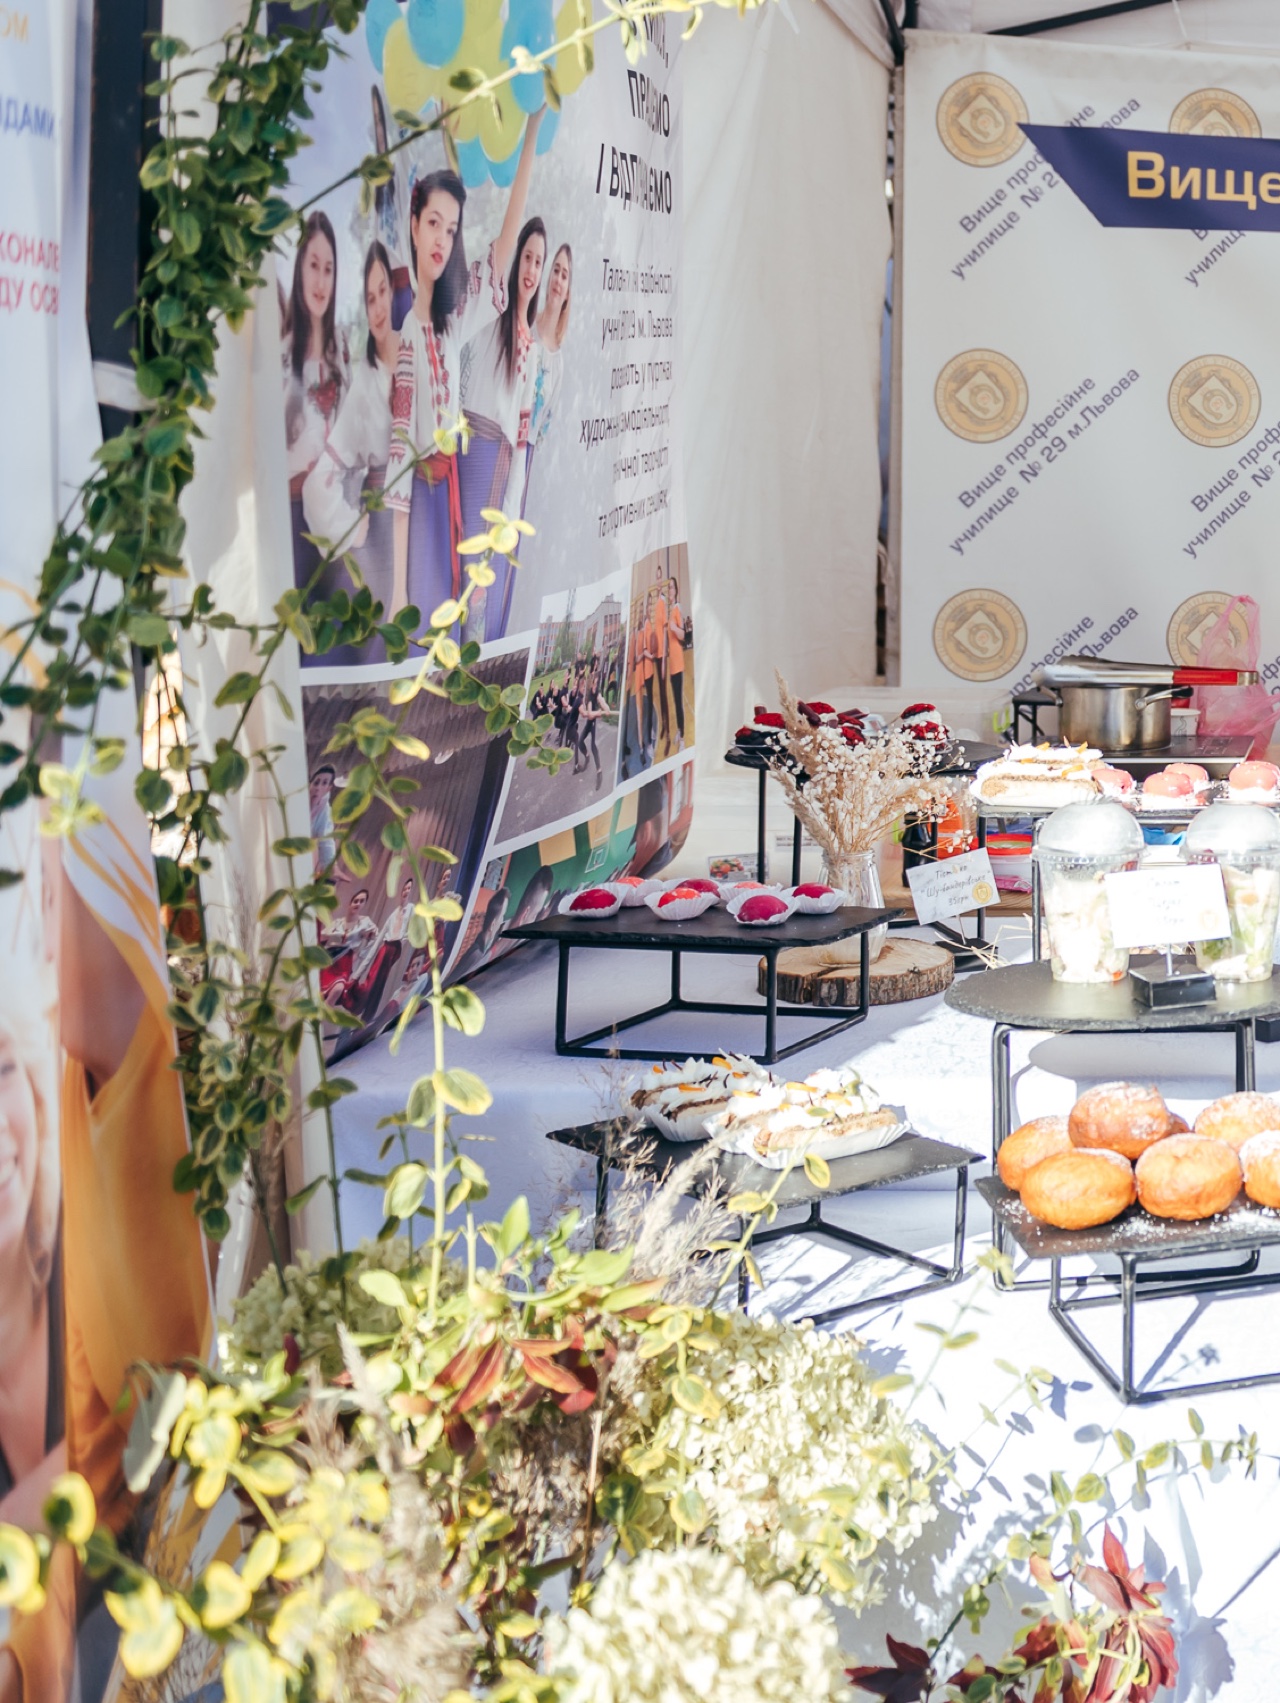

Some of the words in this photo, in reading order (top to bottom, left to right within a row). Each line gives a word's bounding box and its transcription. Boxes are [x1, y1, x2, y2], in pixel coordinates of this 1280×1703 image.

[951, 209, 1021, 280] училище
[1019, 186, 1044, 210] №
[959, 187, 1008, 234] Вище
[949, 485, 1020, 556] училище
[1018, 461, 1044, 484] №
[1040, 435, 1068, 464] 29
[1067, 368, 1141, 440] м.Львова
[957, 464, 1007, 509] Вище
[1005, 376, 1096, 466] професійне
[1183, 489, 1251, 560] училище
[1251, 464, 1275, 488] №
[1190, 468, 1240, 513] Вище
